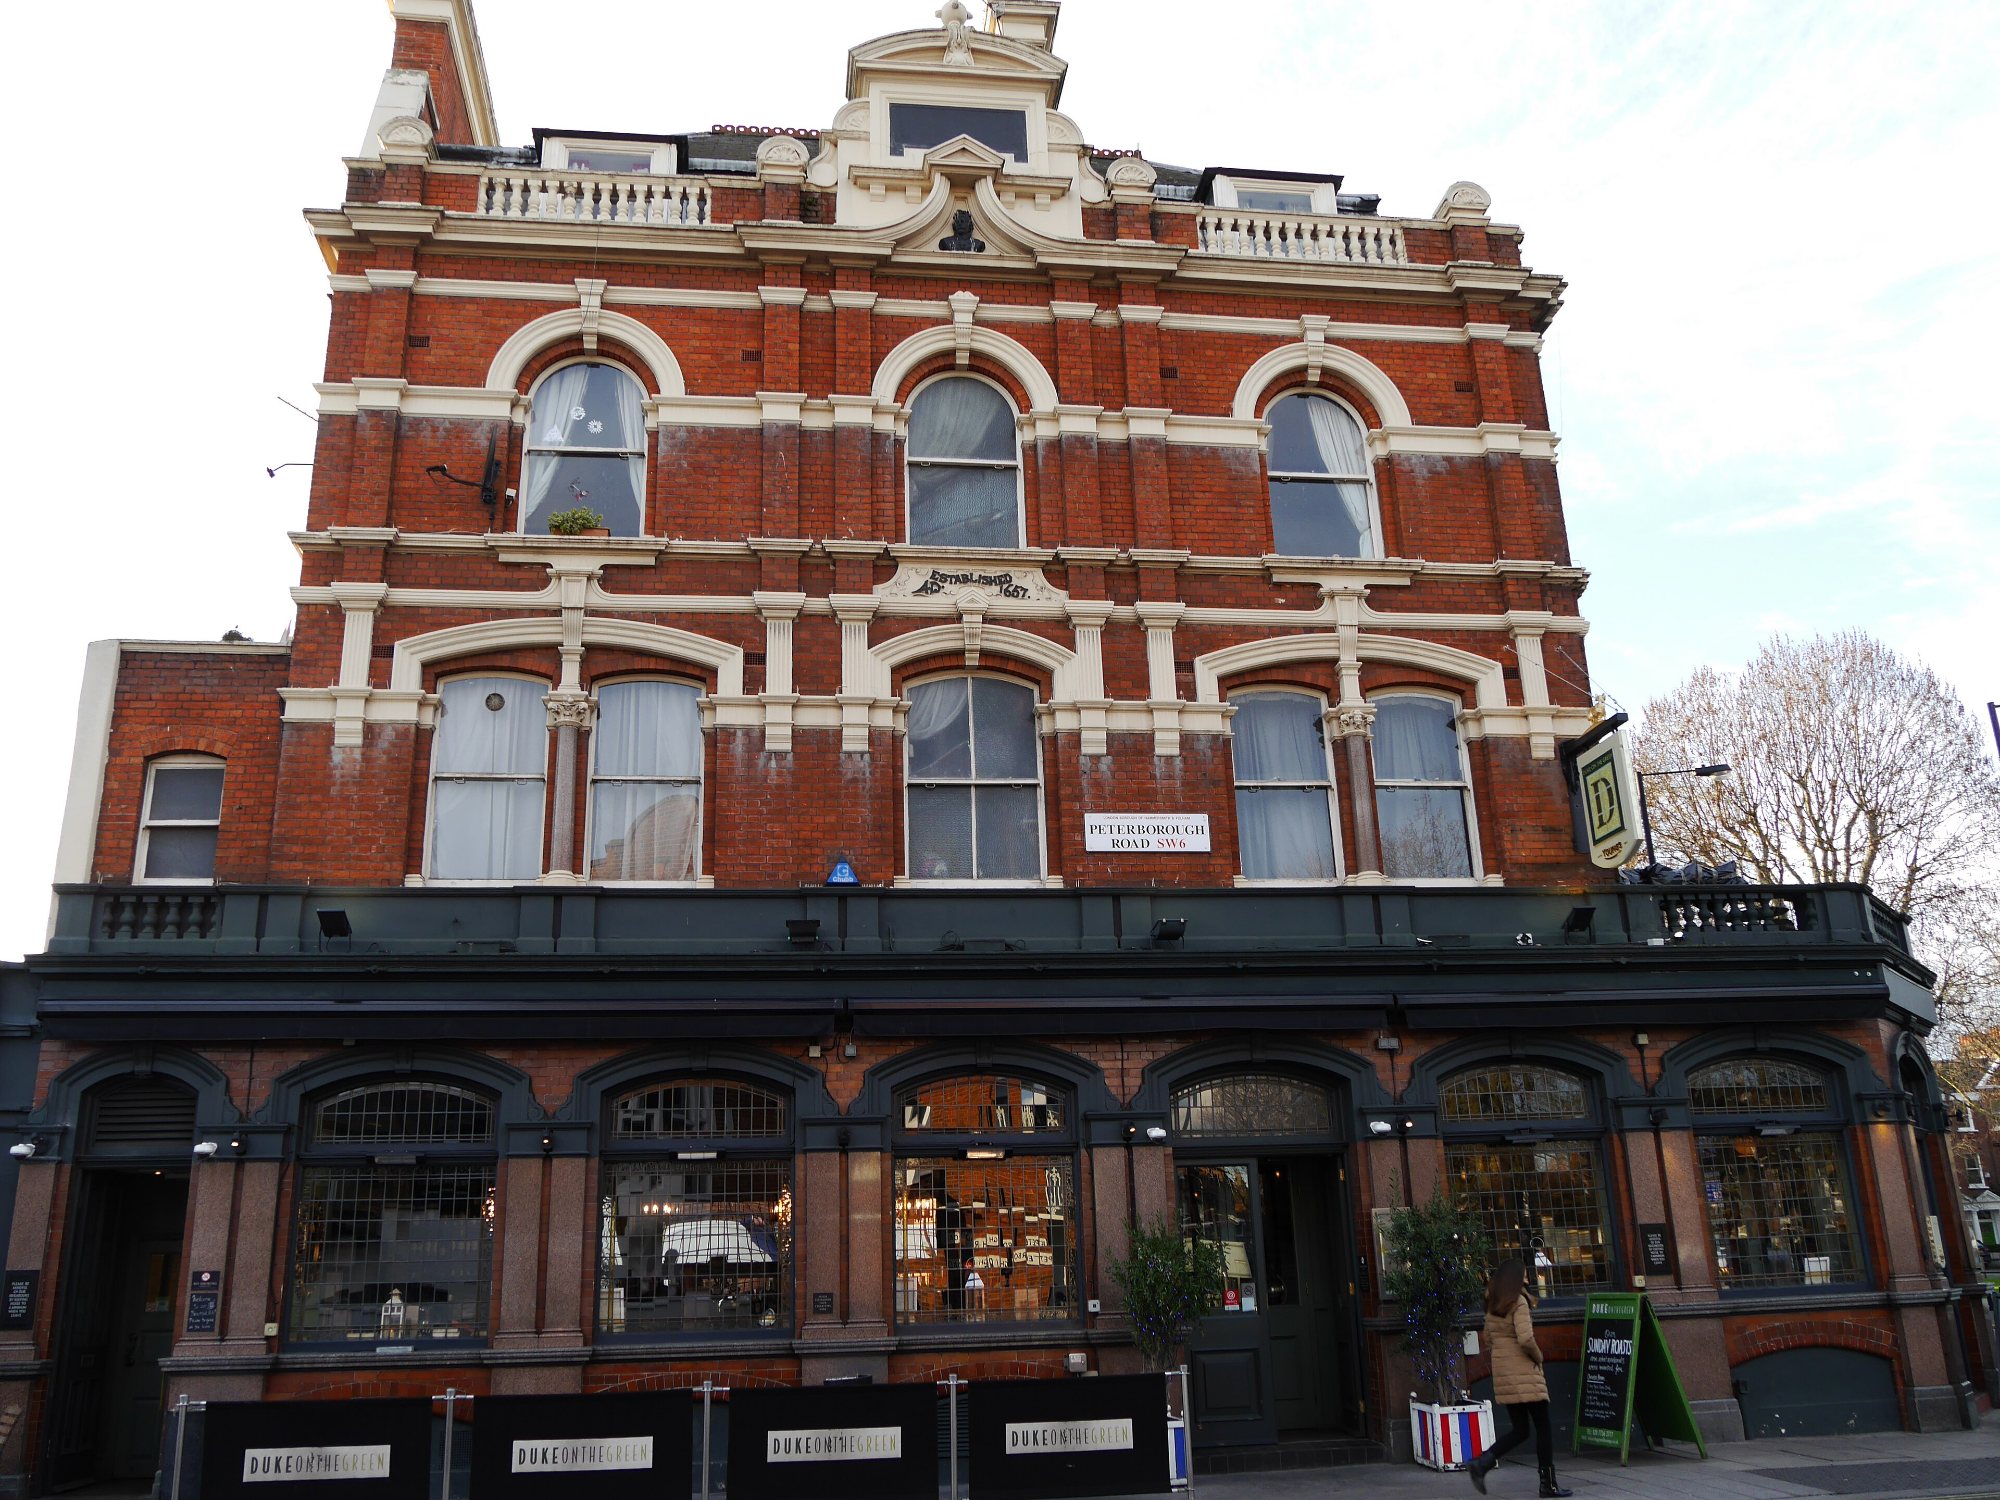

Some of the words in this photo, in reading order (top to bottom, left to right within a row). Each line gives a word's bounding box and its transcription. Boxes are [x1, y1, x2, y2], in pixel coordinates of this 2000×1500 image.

[929, 570, 1013, 586] ESTABLISHED
[1591, 777, 1615, 829] D
[1090, 824, 1205, 835] PETERBOROUGH
[1111, 838, 1150, 849] ROAD
[1157, 839, 1186, 849] SW6
[1587, 1338, 1611, 1354] SUNDAY
[1611, 1338, 1632, 1355] ROASTS
[773, 1434, 896, 1455] DUKEONTHEGREEN
[1011, 1426, 1128, 1447] DUKEONTHEGREEN
[250, 1452, 385, 1474] DUKEONTHEGREEN
[518, 1444, 647, 1465] DUKEONTHEGREEN
